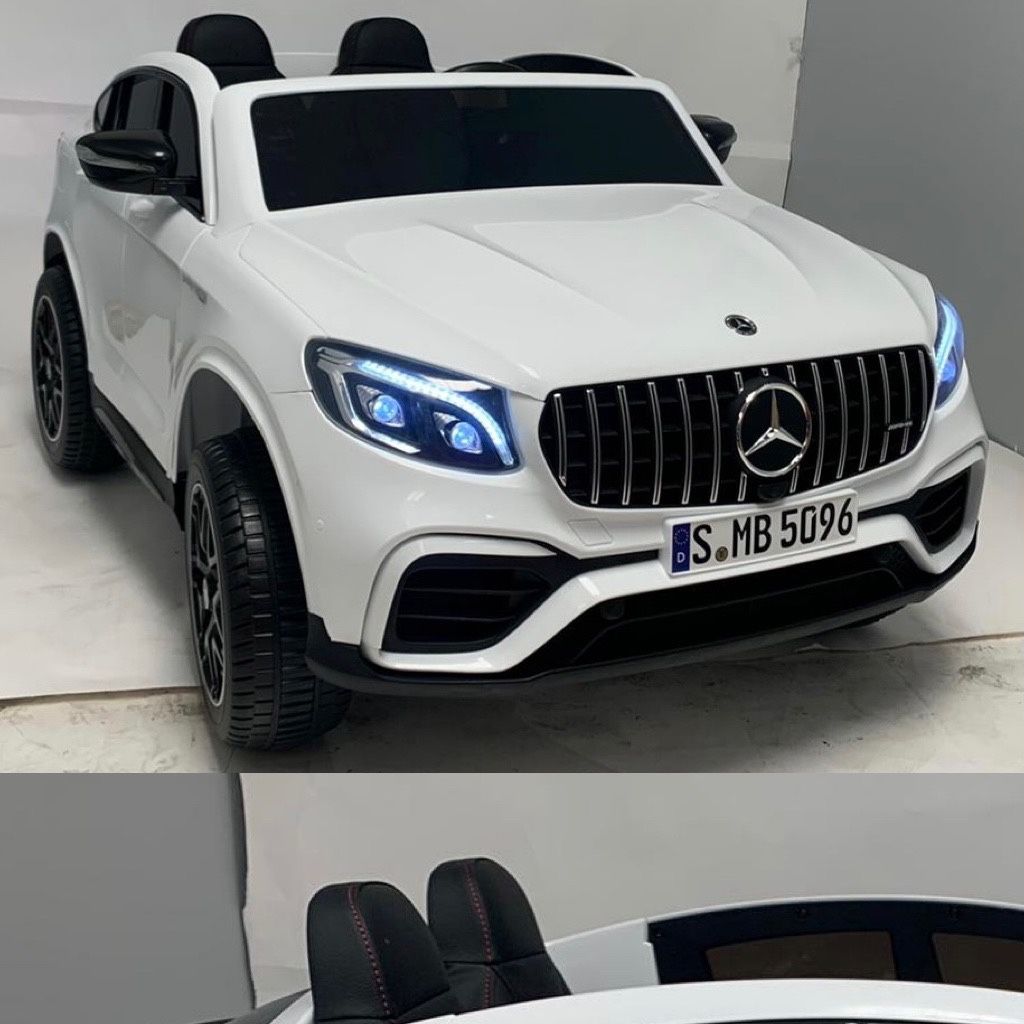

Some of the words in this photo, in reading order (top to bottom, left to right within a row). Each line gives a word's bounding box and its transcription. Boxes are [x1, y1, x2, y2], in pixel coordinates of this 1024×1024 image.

[732, 514, 772, 558] MB
[780, 497, 852, 548] 5096
[677, 551, 685, 563] D
